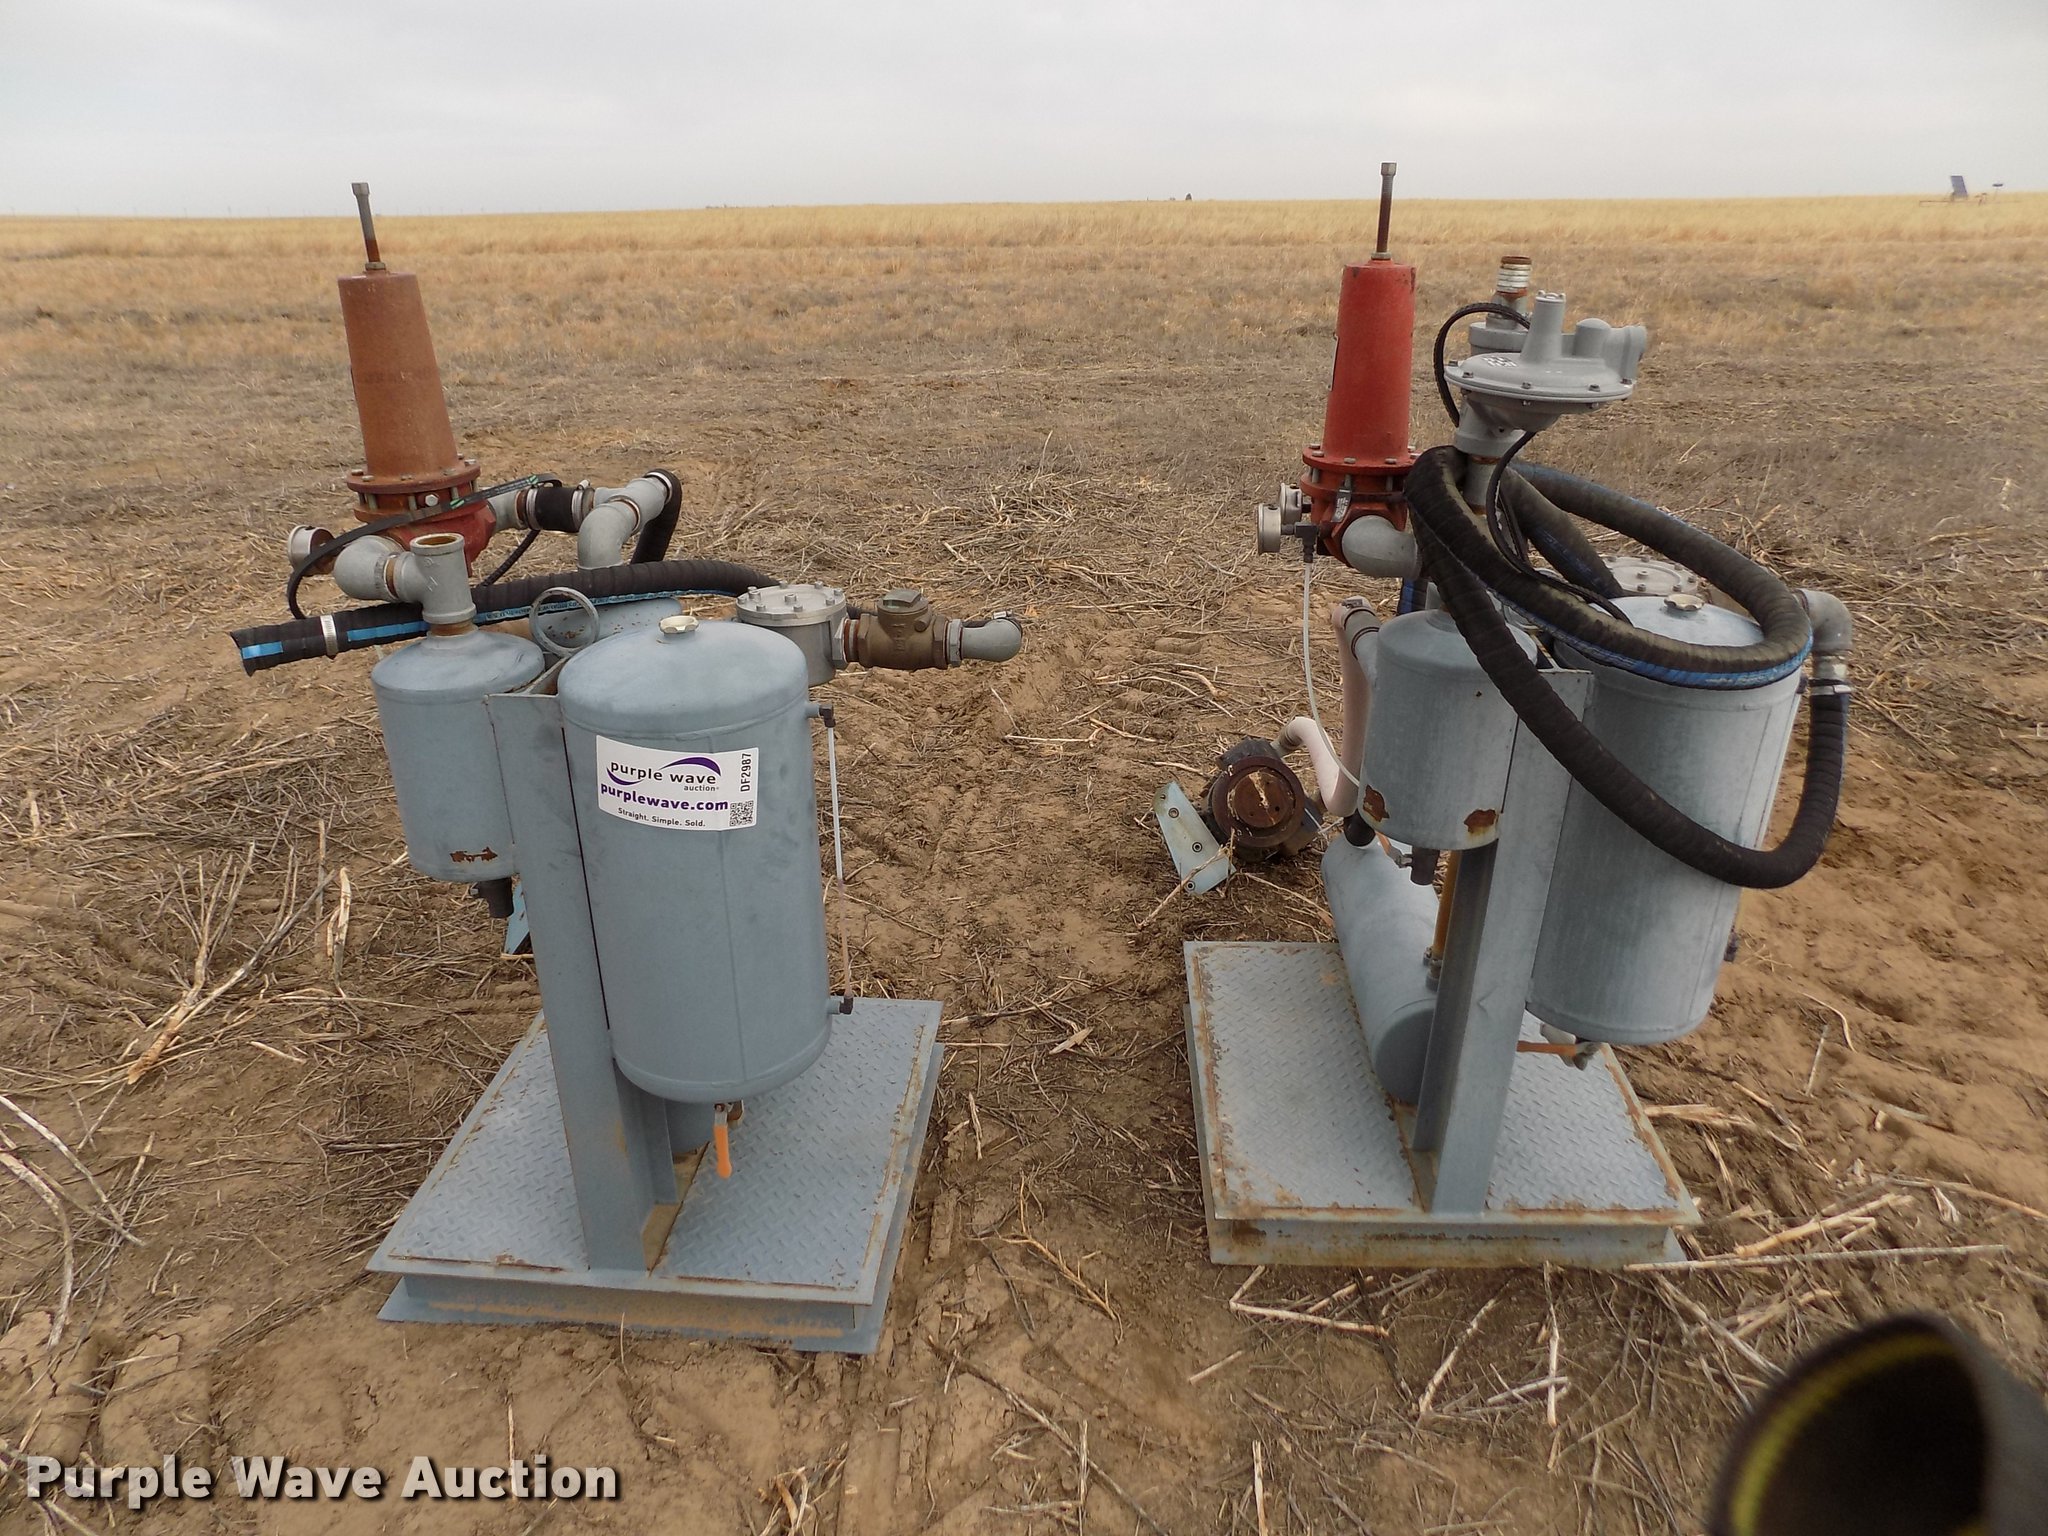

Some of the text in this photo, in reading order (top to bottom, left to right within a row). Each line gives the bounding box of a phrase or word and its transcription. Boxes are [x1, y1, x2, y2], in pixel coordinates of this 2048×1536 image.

[610, 761, 716, 784] purple wave
[740, 753, 752, 792] DF2987
[600, 783, 728, 811] purplewave.com
[618, 807, 706, 827] Straight. Simple. Sold.
